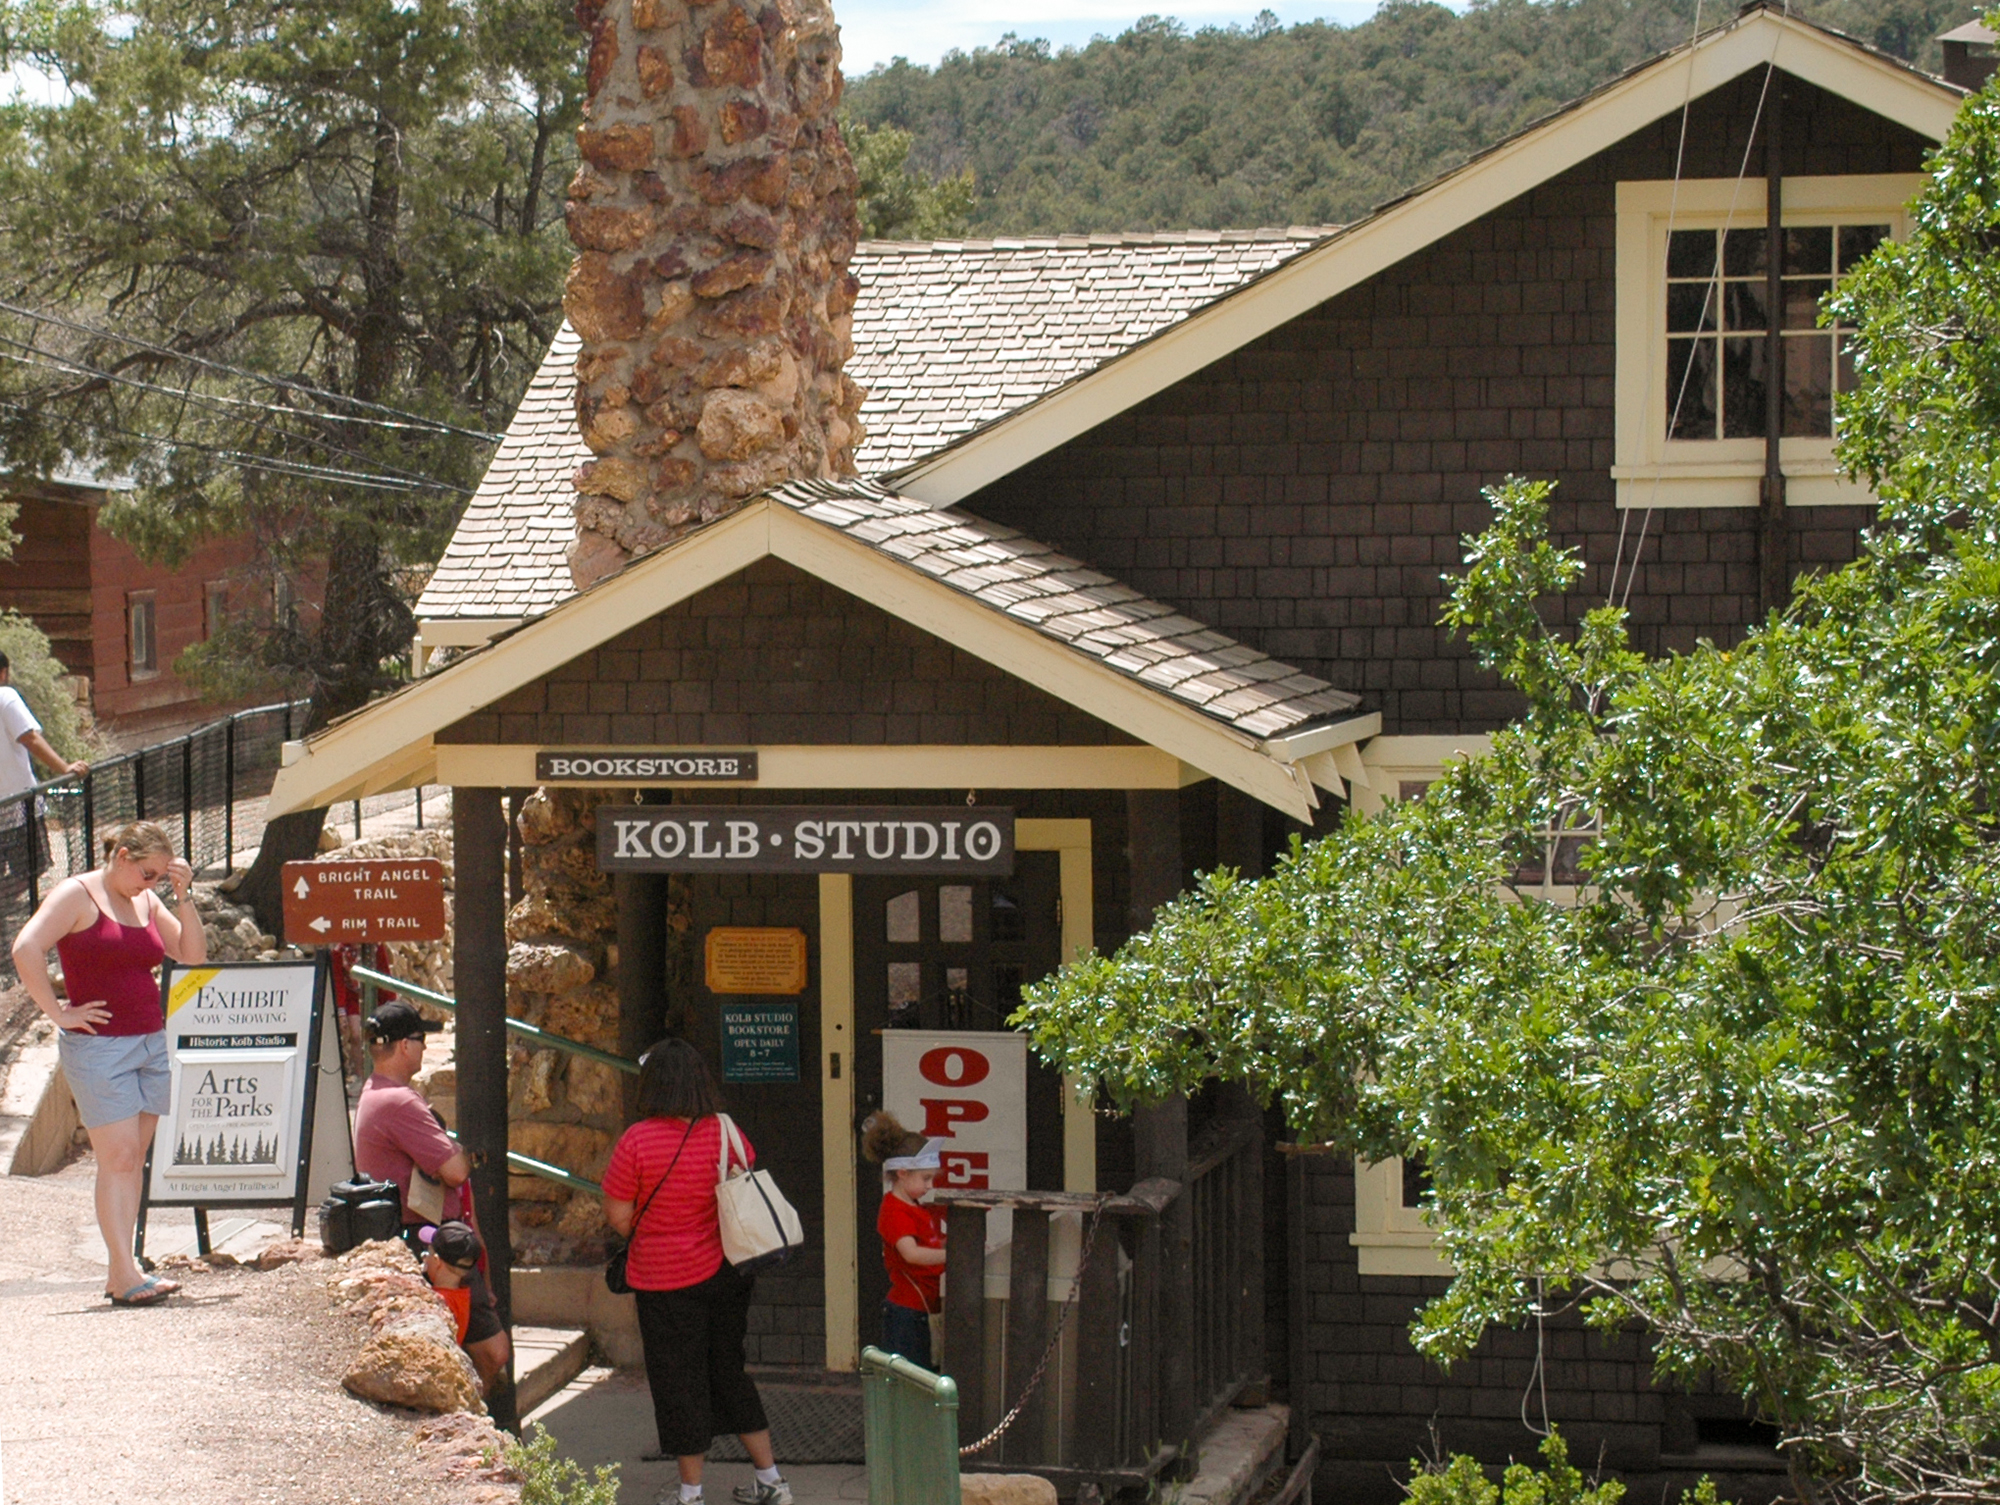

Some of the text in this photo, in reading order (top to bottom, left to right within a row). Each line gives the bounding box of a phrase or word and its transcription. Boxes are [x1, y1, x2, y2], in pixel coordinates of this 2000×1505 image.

[550, 758, 740, 776] BOOKSTORE
[613, 820, 1002, 861] KOLB STUDIO
[318, 869, 430, 883] BRIGHT ANGEL
[353, 888, 398, 900] TRAIL
[342, 917, 420, 929] RIM TRAIL
[193, 1012, 287, 1024] NOW SHOWING
[725, 1013, 793, 1022] KOLB STUDIO
[728, 1025, 790, 1035] BOOKSTORE
[189, 1034, 286, 1047] Historic Kolb Studio
[734, 1039, 785, 1047] OPEN DAILY
[196, 1069, 258, 1094] Arts
[191, 1097, 213, 1107] FOR
[191, 1095, 273, 1118] THE Parks
